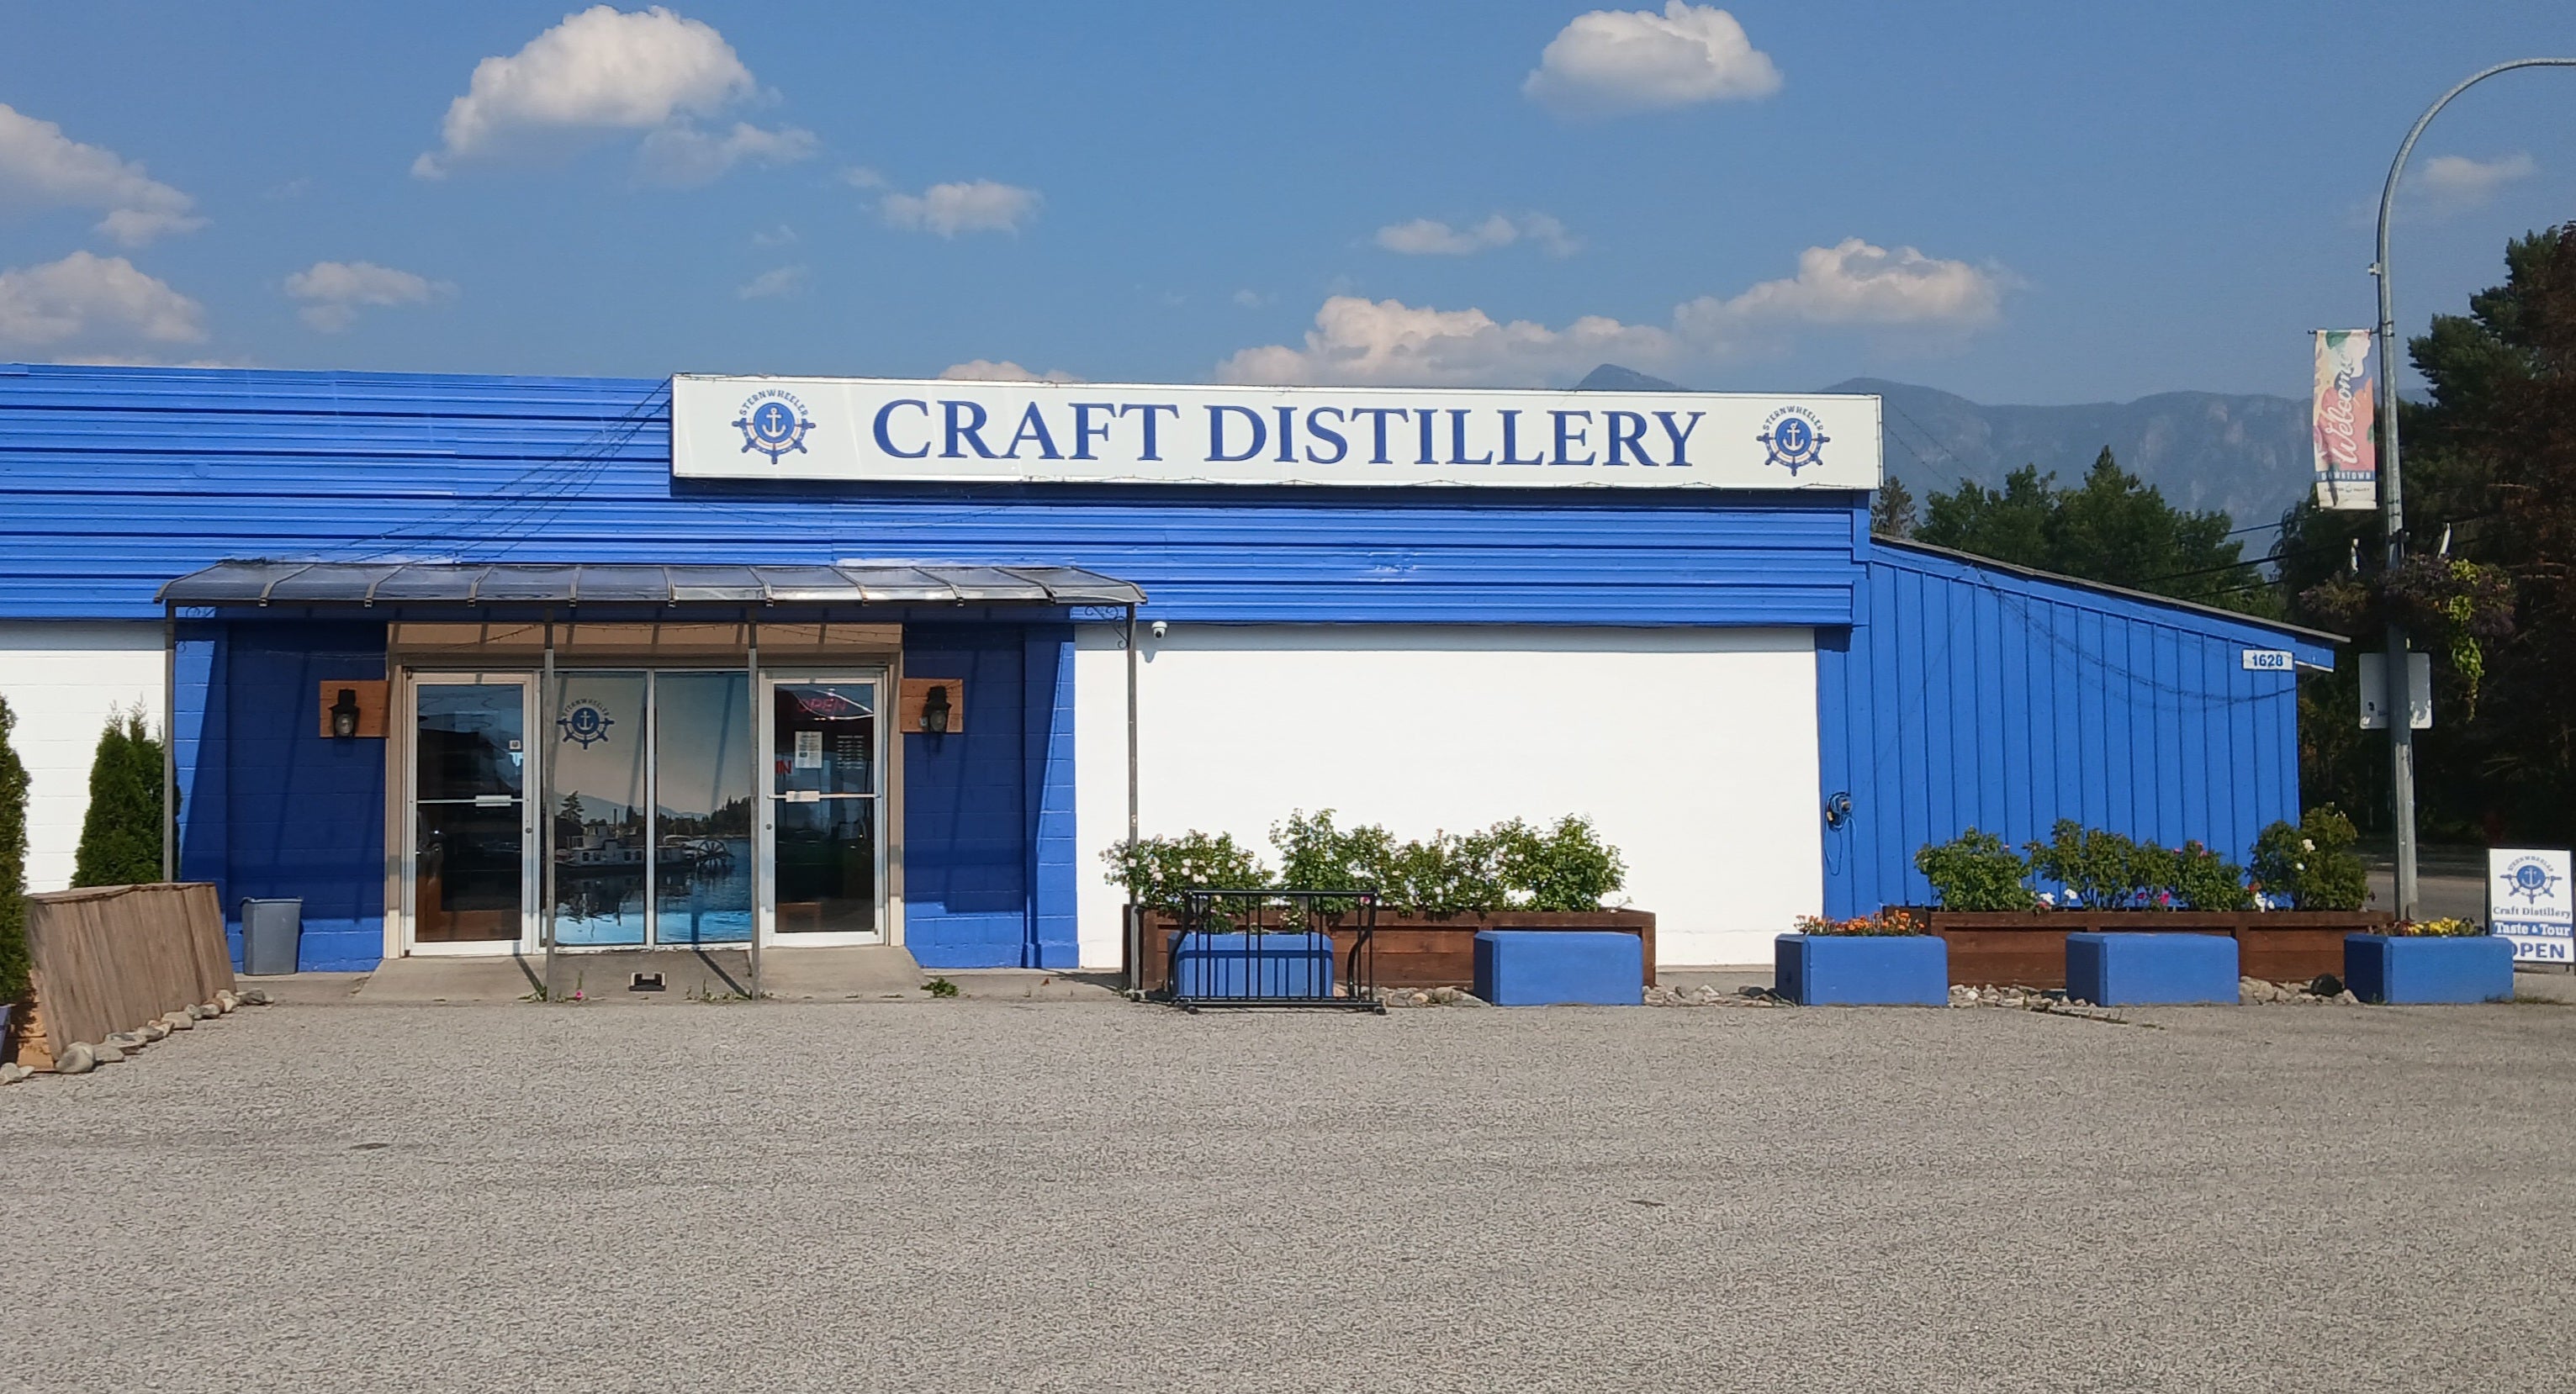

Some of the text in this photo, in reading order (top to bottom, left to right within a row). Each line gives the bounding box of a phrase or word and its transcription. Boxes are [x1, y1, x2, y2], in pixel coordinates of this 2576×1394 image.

[739, 388, 809, 416] STERNWHEELER
[1762, 405, 1824, 431] STERNWHEELER
[872, 399, 1706, 467] CRAFT DISTILLERY
[2251, 654, 2283, 667] 1628
[797, 697, 848, 713] OPEN
[2493, 906, 2571, 920] Craft Distillery
[2494, 921, 2529, 934] Taste
[2540, 923, 2571, 936] Tour
